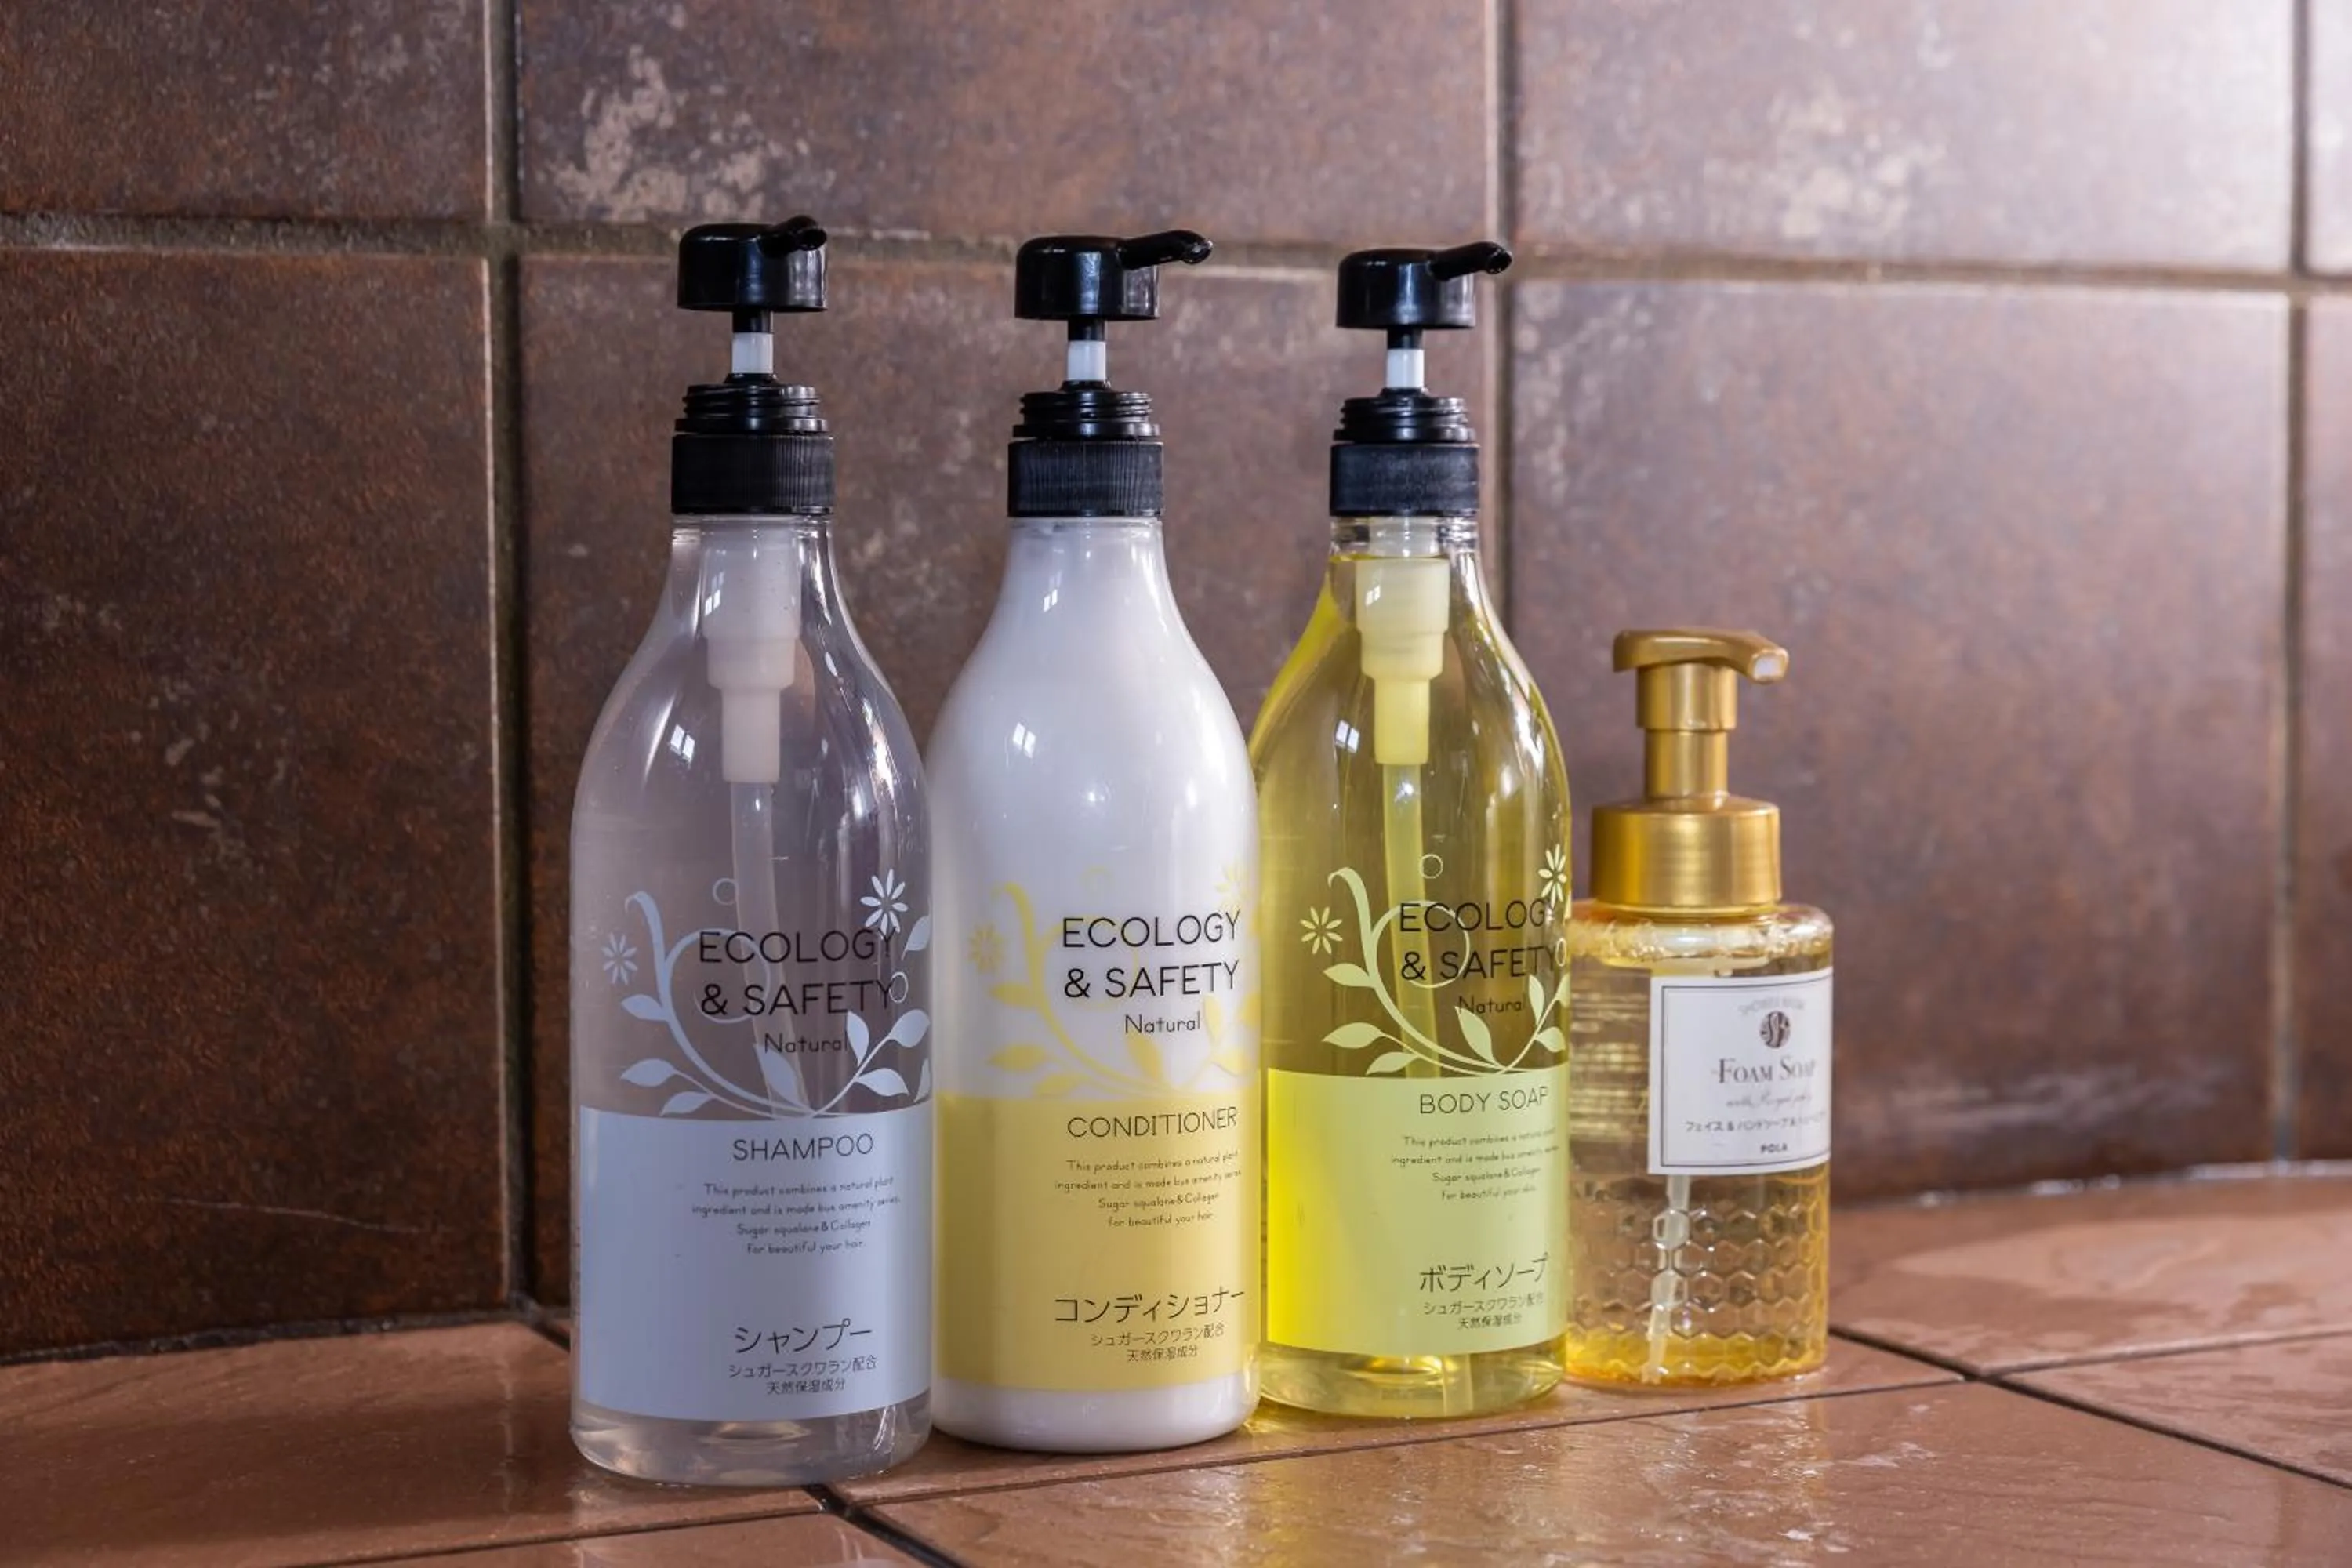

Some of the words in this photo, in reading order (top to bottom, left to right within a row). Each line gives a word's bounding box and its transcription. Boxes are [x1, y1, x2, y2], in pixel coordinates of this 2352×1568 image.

[1062, 909, 1241, 949] ECOLOGY
[698, 927, 899, 964] ECOLOGY
[1399, 950, 1426, 981] &
[1439, 945, 1557, 980] SAFETY
[1063, 967, 1091, 999] &
[1105, 959, 1240, 998] SAFETY
[700, 982, 728, 1016] &
[743, 978, 895, 1016] SAFETY
[1457, 993, 1526, 1014] Natural
[1124, 1011, 1201, 1035] Natural
[764, 1033, 848, 1054] Natural
[1717, 1057, 1774, 1084] FOAM
[1419, 1091, 1492, 1115] BODY
[1497, 1086, 1550, 1112] SOAP
[1066, 1106, 1238, 1138] CONDITIONER
[732, 1133, 874, 1162] SHAMPOO
[1428, 1136, 1468, 1149] product
[1759, 1143, 1788, 1153] POLA
[1066, 1159, 1091, 1171] This
[1094, 1159, 1135, 1174] product
[1138, 1157, 1182, 1171] combines
[1192, 1150, 1221, 1165] natural
[1391, 1154, 1443, 1168] ingredient
[1445, 1153, 1464, 1165] and
[1465, 1154, 1474, 1164] is
[703, 1182, 728, 1196] This
[731, 1184, 775, 1199] product
[779, 1182, 828, 1195] combines
[840, 1177, 873, 1191] natural
[1054, 1179, 1109, 1193] ingredient
[1110, 1179, 1131, 1190] and
[1134, 1181, 1142, 1189] is
[1145, 1176, 1171, 1189] made
[1432, 1171, 1463, 1186] Sugar
[691, 1205, 746, 1218] ingredient
[750, 1203, 771, 1216] and
[774, 1203, 783, 1215] is
[786, 1203, 815, 1216] made
[1098, 1197, 1130, 1213] Sugar
[735, 1222, 769, 1240] Sugar
[1127, 1213, 1173, 1228] beautiful
[1175, 1214, 1196, 1225] your
[768, 1240, 817, 1254] beautiful
[818, 1244, 843, 1254] your
[1418, 1251, 1549, 1294] ボディソープ
[1054, 1285, 1246, 1324] コンディショナー
[734, 1317, 873, 1355] シャンプー
[1090, 1322, 1226, 1347] シュガースクワラン配合
[728, 1354, 878, 1379] シュガースクワラン配合
